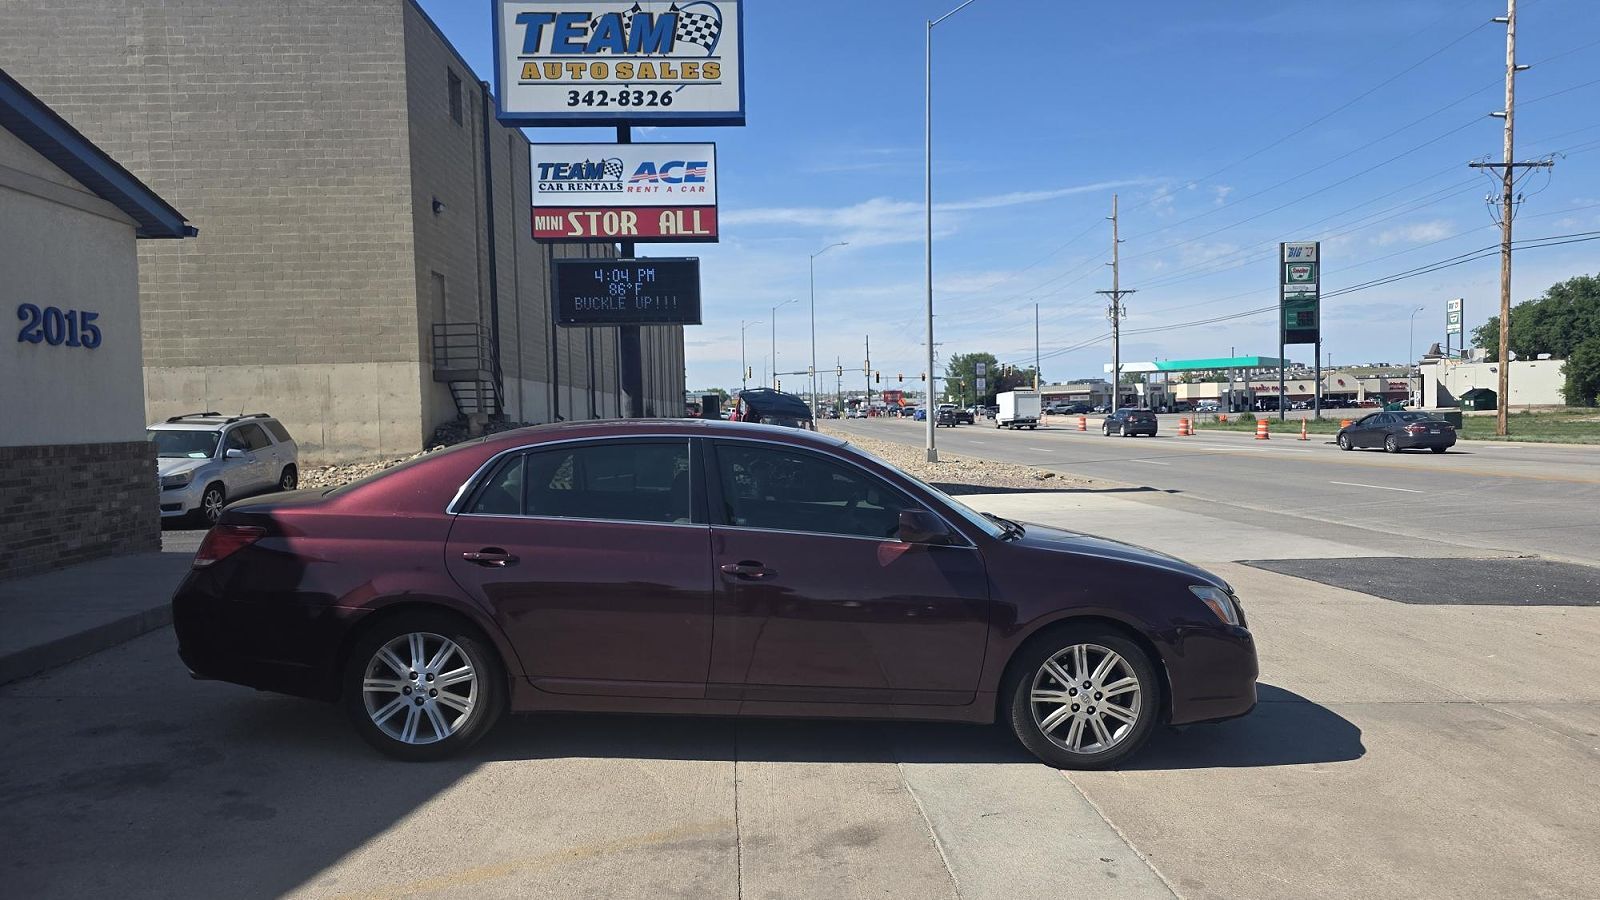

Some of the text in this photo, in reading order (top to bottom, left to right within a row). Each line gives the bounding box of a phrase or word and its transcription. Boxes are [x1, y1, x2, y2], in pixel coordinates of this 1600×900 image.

[515, 12, 681, 55] TEAM
[520, 62, 722, 80] AUTO SALES
[567, 90, 673, 107] 342-8326
[538, 162, 605, 181] TEAM
[628, 160, 708, 184] ACE
[538, 182, 624, 191] CAR RENTALS
[535, 210, 711, 236] MINI STOR ALL
[594, 268, 655, 282] 4:04 PM
[574, 295, 677, 311] BUCKLE UP!!!
[17, 303, 102, 349] 2015
